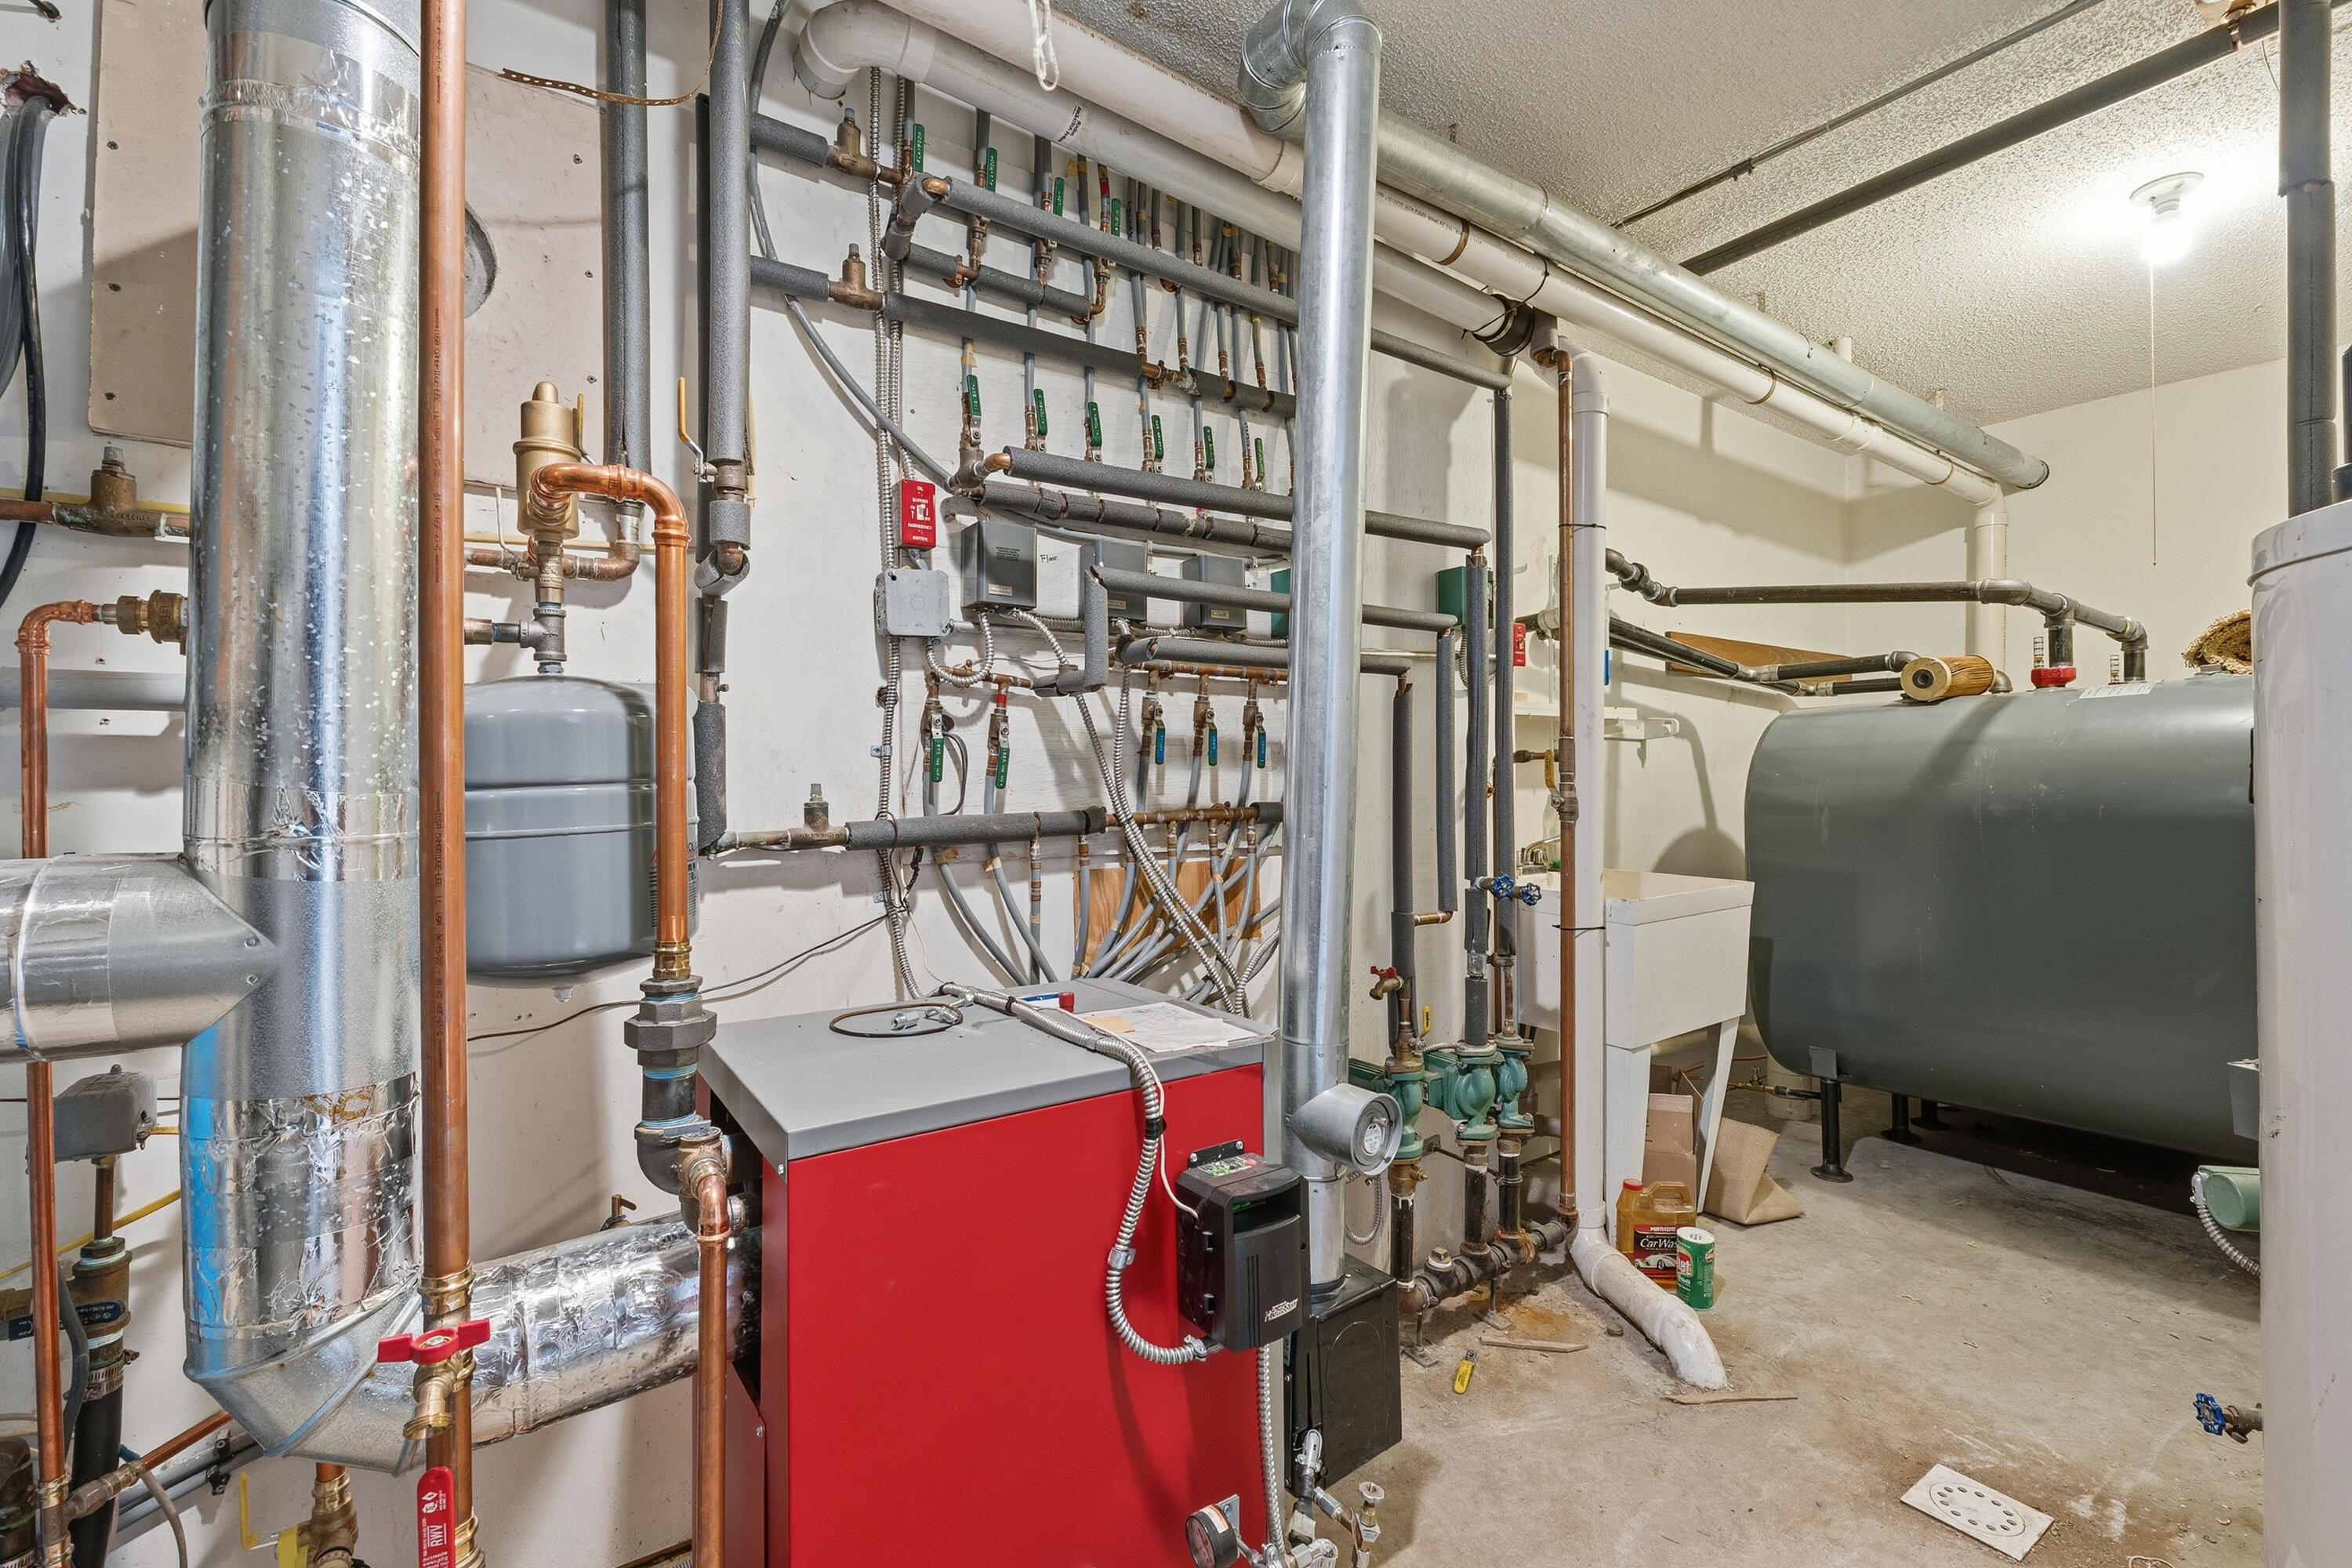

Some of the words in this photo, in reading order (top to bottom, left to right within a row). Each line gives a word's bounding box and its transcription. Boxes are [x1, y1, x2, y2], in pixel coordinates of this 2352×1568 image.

[1040, 554, 1058, 563] Floor
[1640, 1238, 1678, 1248] CarWas
[430, 1525, 444, 1548] RWV
